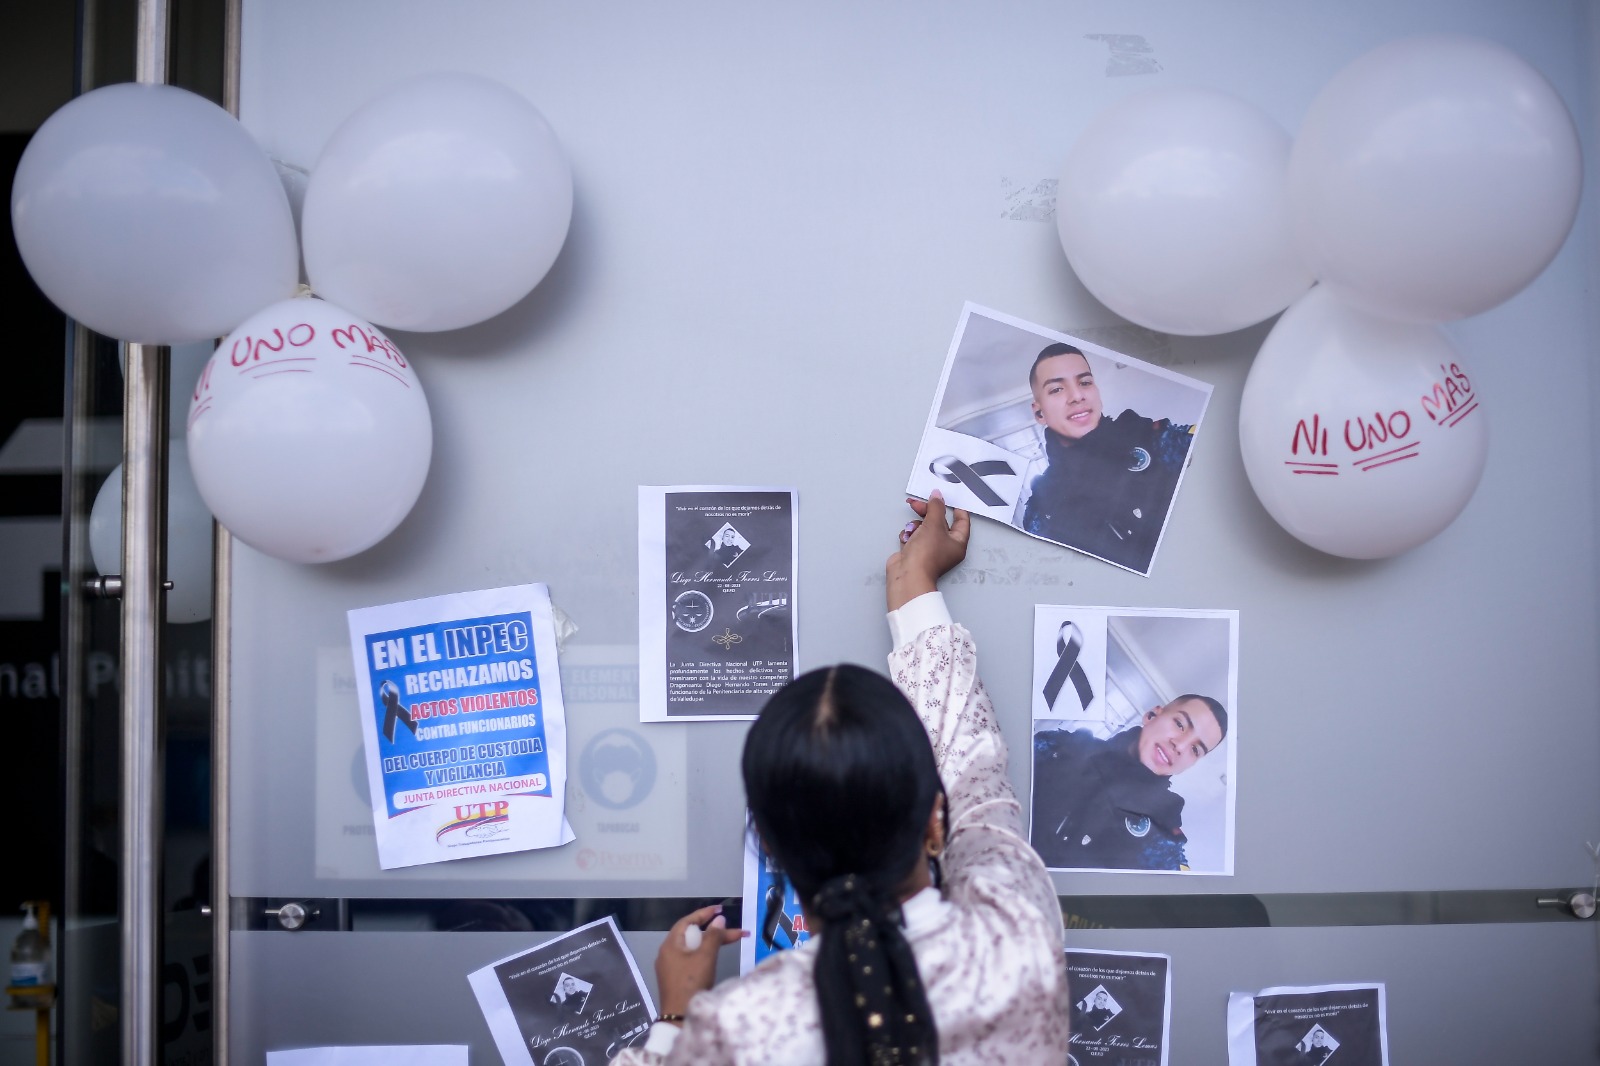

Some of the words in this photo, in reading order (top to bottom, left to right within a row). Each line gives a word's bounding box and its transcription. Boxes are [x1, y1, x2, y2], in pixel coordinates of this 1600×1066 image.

[231, 323, 315, 367] UNO
[1291, 413, 1327, 456] NI
[1344, 410, 1411, 452] UNO
[1420, 363, 1471, 420] MÁS
[670, 572, 692, 586] Diego
[694, 570, 732, 582] Hernando
[736, 570, 760, 582] Torres
[763, 570, 788, 582] Lemus
[372, 637, 407, 671] EN
[411, 632, 442, 664] EL
[443, 620, 529, 660] INPEC
[405, 658, 534, 696] RECHAZAMOS
[572, 669, 639, 684] ELEMENT
[410, 698, 458, 721] ACTOS
[459, 688, 538, 714] VIOLENTOS
[416, 721, 458, 741] CONTRA
[458, 713, 536, 735] FUNCIONARIOS
[384, 756, 408, 774] DEL
[409, 748, 458, 770] CUERPO
[460, 745, 476, 762] DE
[477, 737, 542, 760] CUSTODIA
[426, 771, 434, 786] Y
[436, 761, 506, 784] VIGILANCIA
[403, 792, 435, 804] JUNTA
[436, 784, 487, 799] DIRECTIVA
[488, 777, 542, 793] NACIONAL
[452, 800, 510, 821] UTP
[530, 1036, 552, 1050] Diego
[552, 1020, 590, 1042] Hernando
[1132, 1036, 1158, 1049] Lemus
